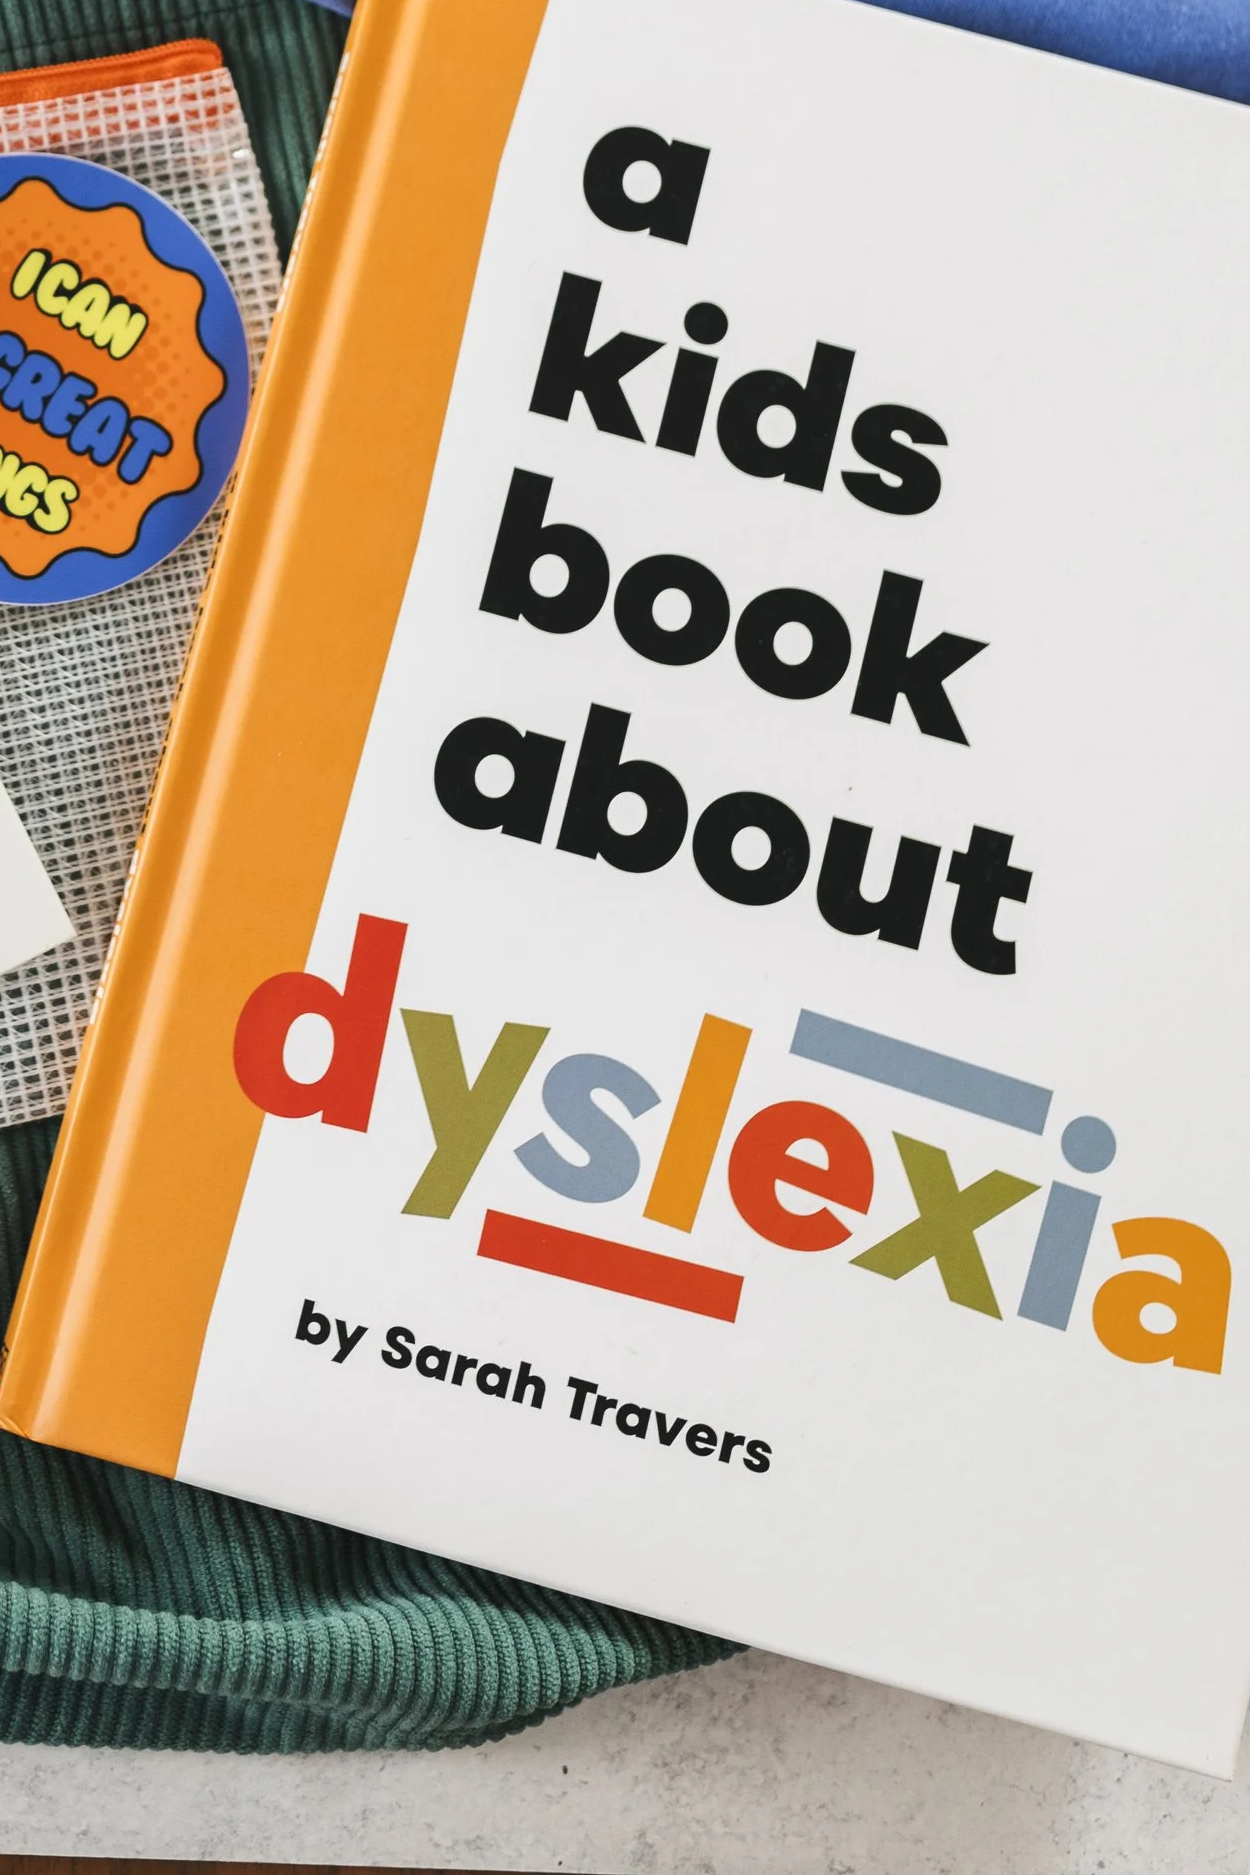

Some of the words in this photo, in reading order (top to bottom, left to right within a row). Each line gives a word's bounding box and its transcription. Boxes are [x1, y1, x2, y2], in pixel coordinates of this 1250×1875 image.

[11, 248, 52, 299] I
[36, 259, 148, 360] CAN
[582, 125, 712, 247] a
[528, 271, 949, 517] kids
[478, 467, 991, 748] book
[433, 702, 1034, 977] about
[232, 912, 1233, 1375] dyslexia
[294, 1297, 369, 1364] by
[380, 1325, 549, 1410] Sarah
[566, 1375, 773, 1474] Travers
